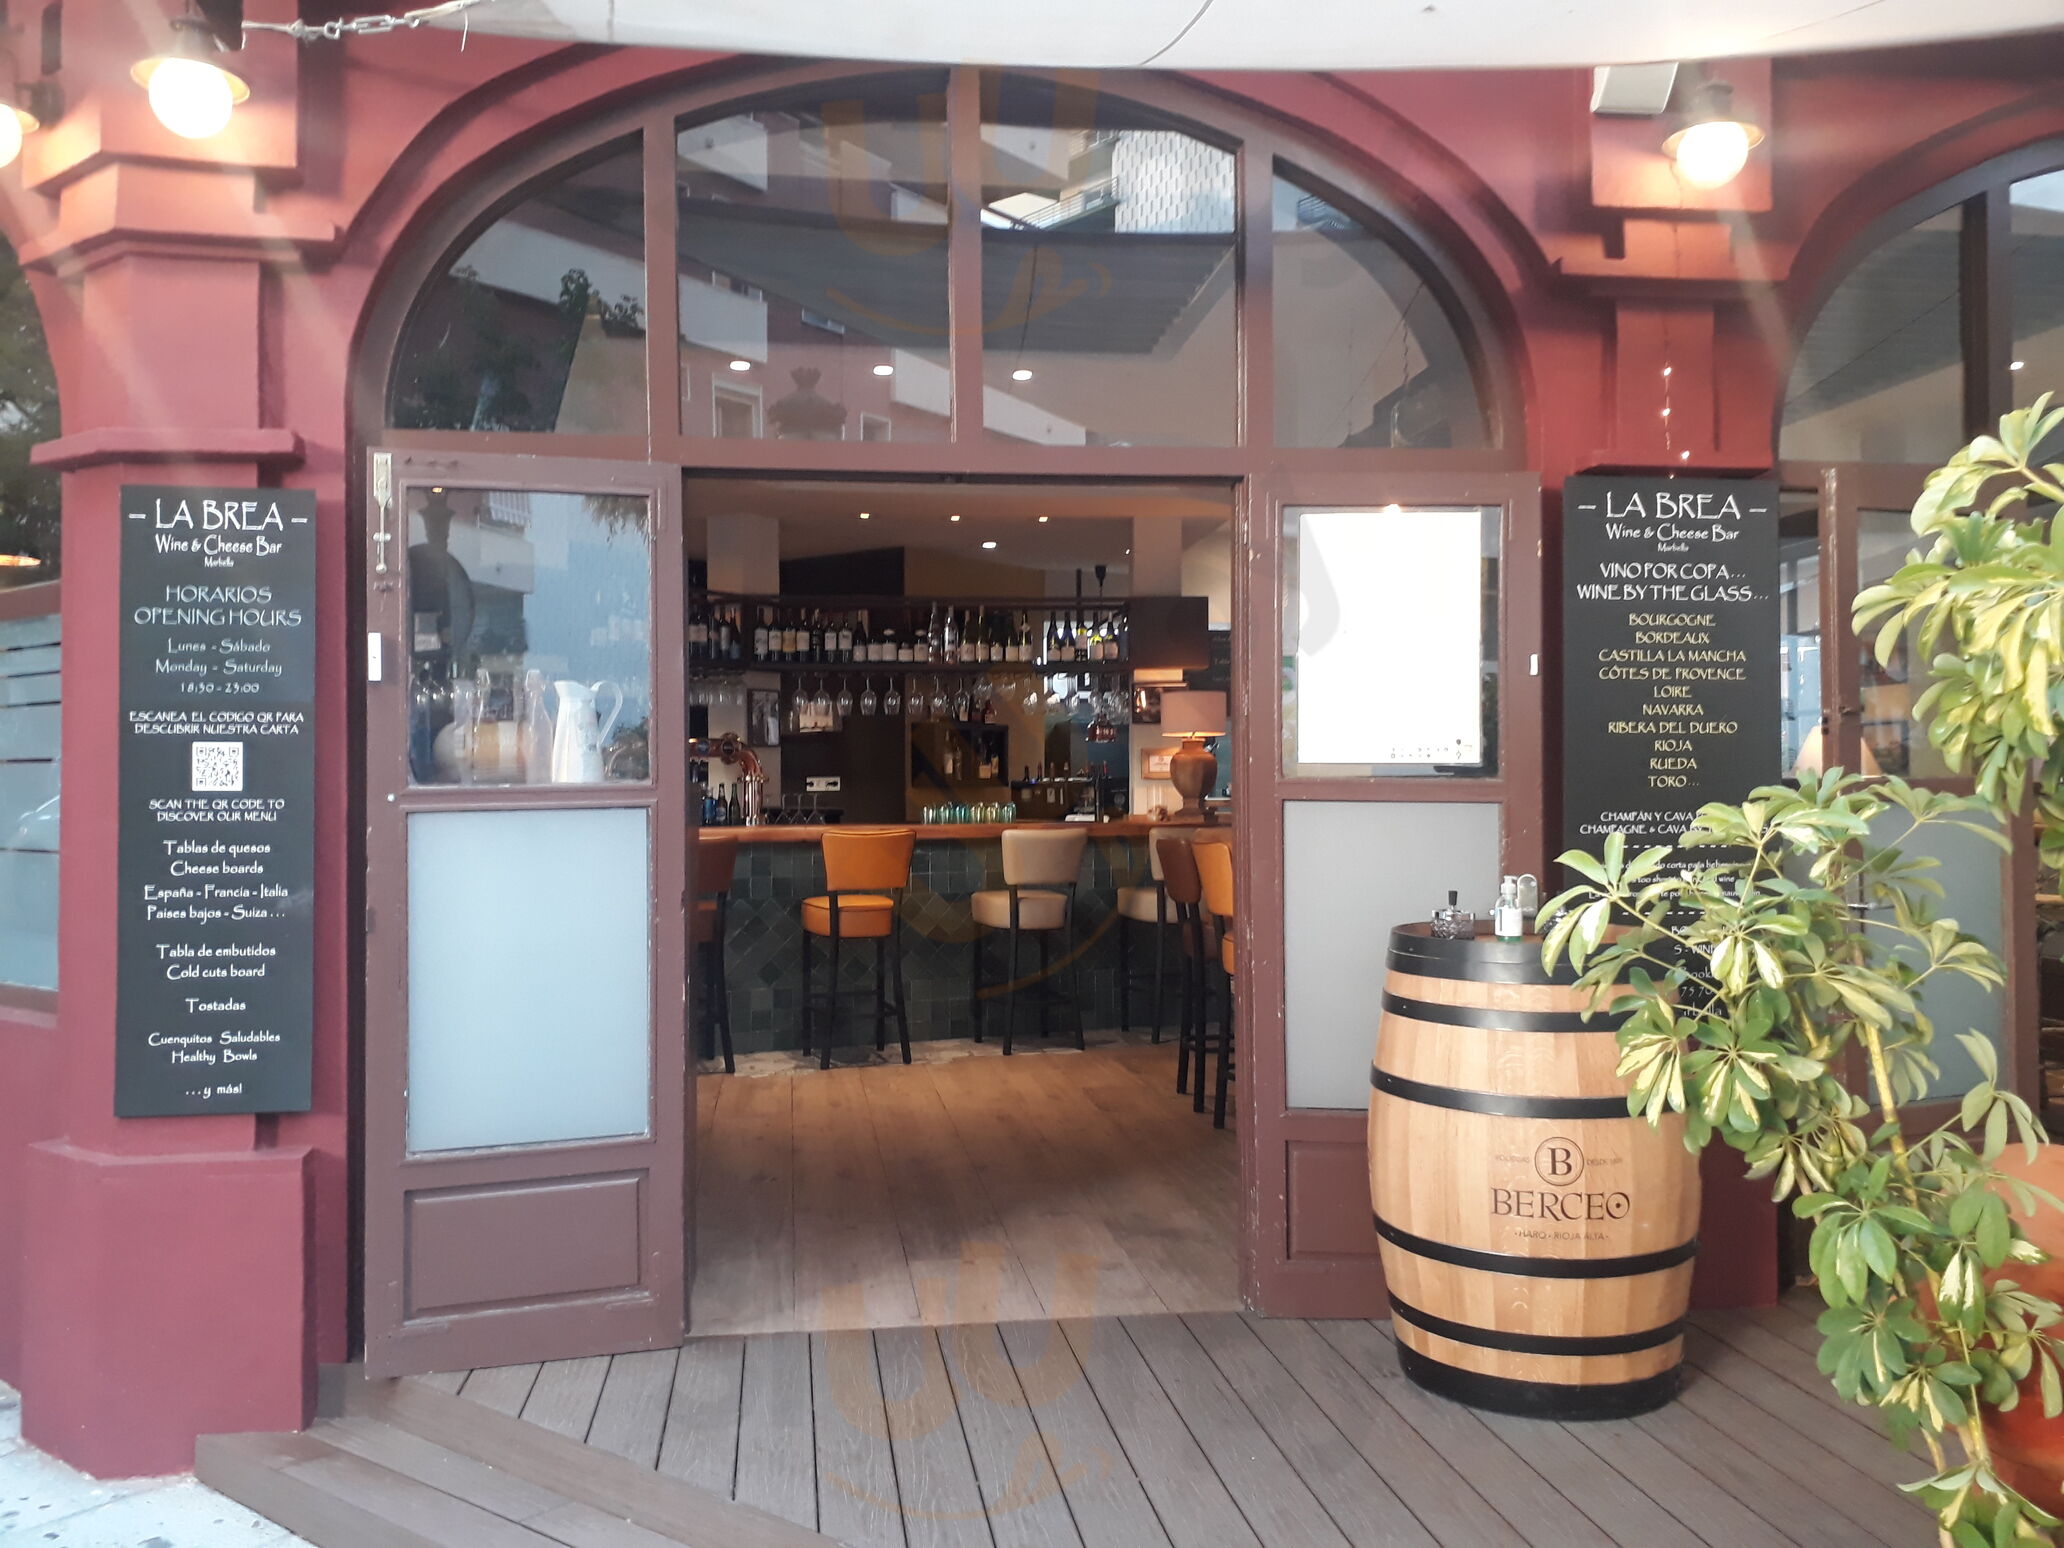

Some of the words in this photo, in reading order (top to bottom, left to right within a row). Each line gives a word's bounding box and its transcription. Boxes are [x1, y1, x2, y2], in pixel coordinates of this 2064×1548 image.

[1606, 491, 1645, 518] LA
[1656, 492, 1741, 519] BREA
[156, 498, 193, 529] LA
[203, 500, 283, 531] BREA
[1606, 523, 1640, 540] Wine
[1644, 528, 1654, 538] &
[1657, 523, 1708, 541] Cheese
[1712, 524, 1739, 542] Bar
[155, 534, 188, 553] Wine
[192, 540, 201, 550] &
[204, 534, 253, 555] Cheese
[256, 536, 282, 556] Bar
[1600, 562, 1641, 578] VINO
[1644, 563, 1677, 579] POR
[166, 585, 272, 603] HORARIOS
[1577, 584, 1621, 599] WINE
[1623, 585, 1646, 599] BY
[1649, 585, 1688, 600] THE
[134, 607, 225, 626] OPENING
[229, 609, 302, 627] HOURS
[1629, 613, 1716, 626] BOURGOGNE
[1636, 631, 1709, 643] BORDEAUX
[168, 638, 206, 654] Lunes
[1598, 650, 1664, 662] CASTILLA
[1668, 650, 1685, 662] LA
[1689, 650, 1746, 662] MANCHA
[156, 659, 207, 676] Monday
[223, 659, 282, 677] Saturday
[1599, 665, 1648, 679] CÔTES
[1652, 668, 1672, 679] DE
[1676, 668, 1746, 680] PROVENCE
[1654, 686, 1692, 698] LOIRE
[130, 711, 186, 723] ESCANEA
[192, 711, 206, 723] EL
[257, 712, 273, 723] QR
[276, 712, 304, 723] PARA
[1643, 704, 1703, 715] NAVARRA
[135, 723, 200, 734] DESCUBRIR
[203, 723, 257, 734] NUESTRA
[260, 724, 299, 734] CARTA
[1608, 721, 1656, 733] RIBERA
[1659, 721, 1686, 733] DEL
[1690, 721, 1737, 734] DUERO
[1654, 739, 1692, 752] RIOJA
[1650, 757, 1697, 770] RUEDA
[149, 799, 182, 810] SCAN
[184, 799, 209, 810] THE
[212, 799, 228, 810] QR
[231, 799, 264, 810] CODE
[267, 799, 285, 809] TO
[158, 811, 214, 822] DISCOVER
[217, 811, 242, 821] OUR
[245, 811, 277, 822] MENU
[1655, 812, 1662, 821] Y
[1664, 812, 1692, 821] CAVA
[1658, 824, 1689, 834] CAVA
[163, 840, 208, 854] Tablas
[211, 840, 226, 854] de
[229, 844, 271, 859] quesos
[170, 860, 219, 876] Cheese
[222, 860, 263, 873] boards
[144, 884, 193, 902] España
[205, 884, 249, 899] Francia
[261, 884, 288, 897] Italia
[190, 905, 221, 924] bajos
[231, 905, 267, 919] Suiza
[156, 944, 194, 958] Tabla
[198, 944, 212, 957] de
[215, 943, 276, 957] embutidos
[166, 965, 200, 980] Cold
[203, 965, 227, 977] cuts
[230, 964, 265, 977] board
[186, 998, 246, 1012] Tostadas
[148, 1033, 212, 1047] Cuenquitos
[220, 1031, 281, 1043] Saludables
[172, 1050, 216, 1064] Healthy
[224, 1050, 257, 1062] Bowls
[1548, 1147, 1572, 1175] B
[1491, 1188, 1630, 1221] BERCEO
